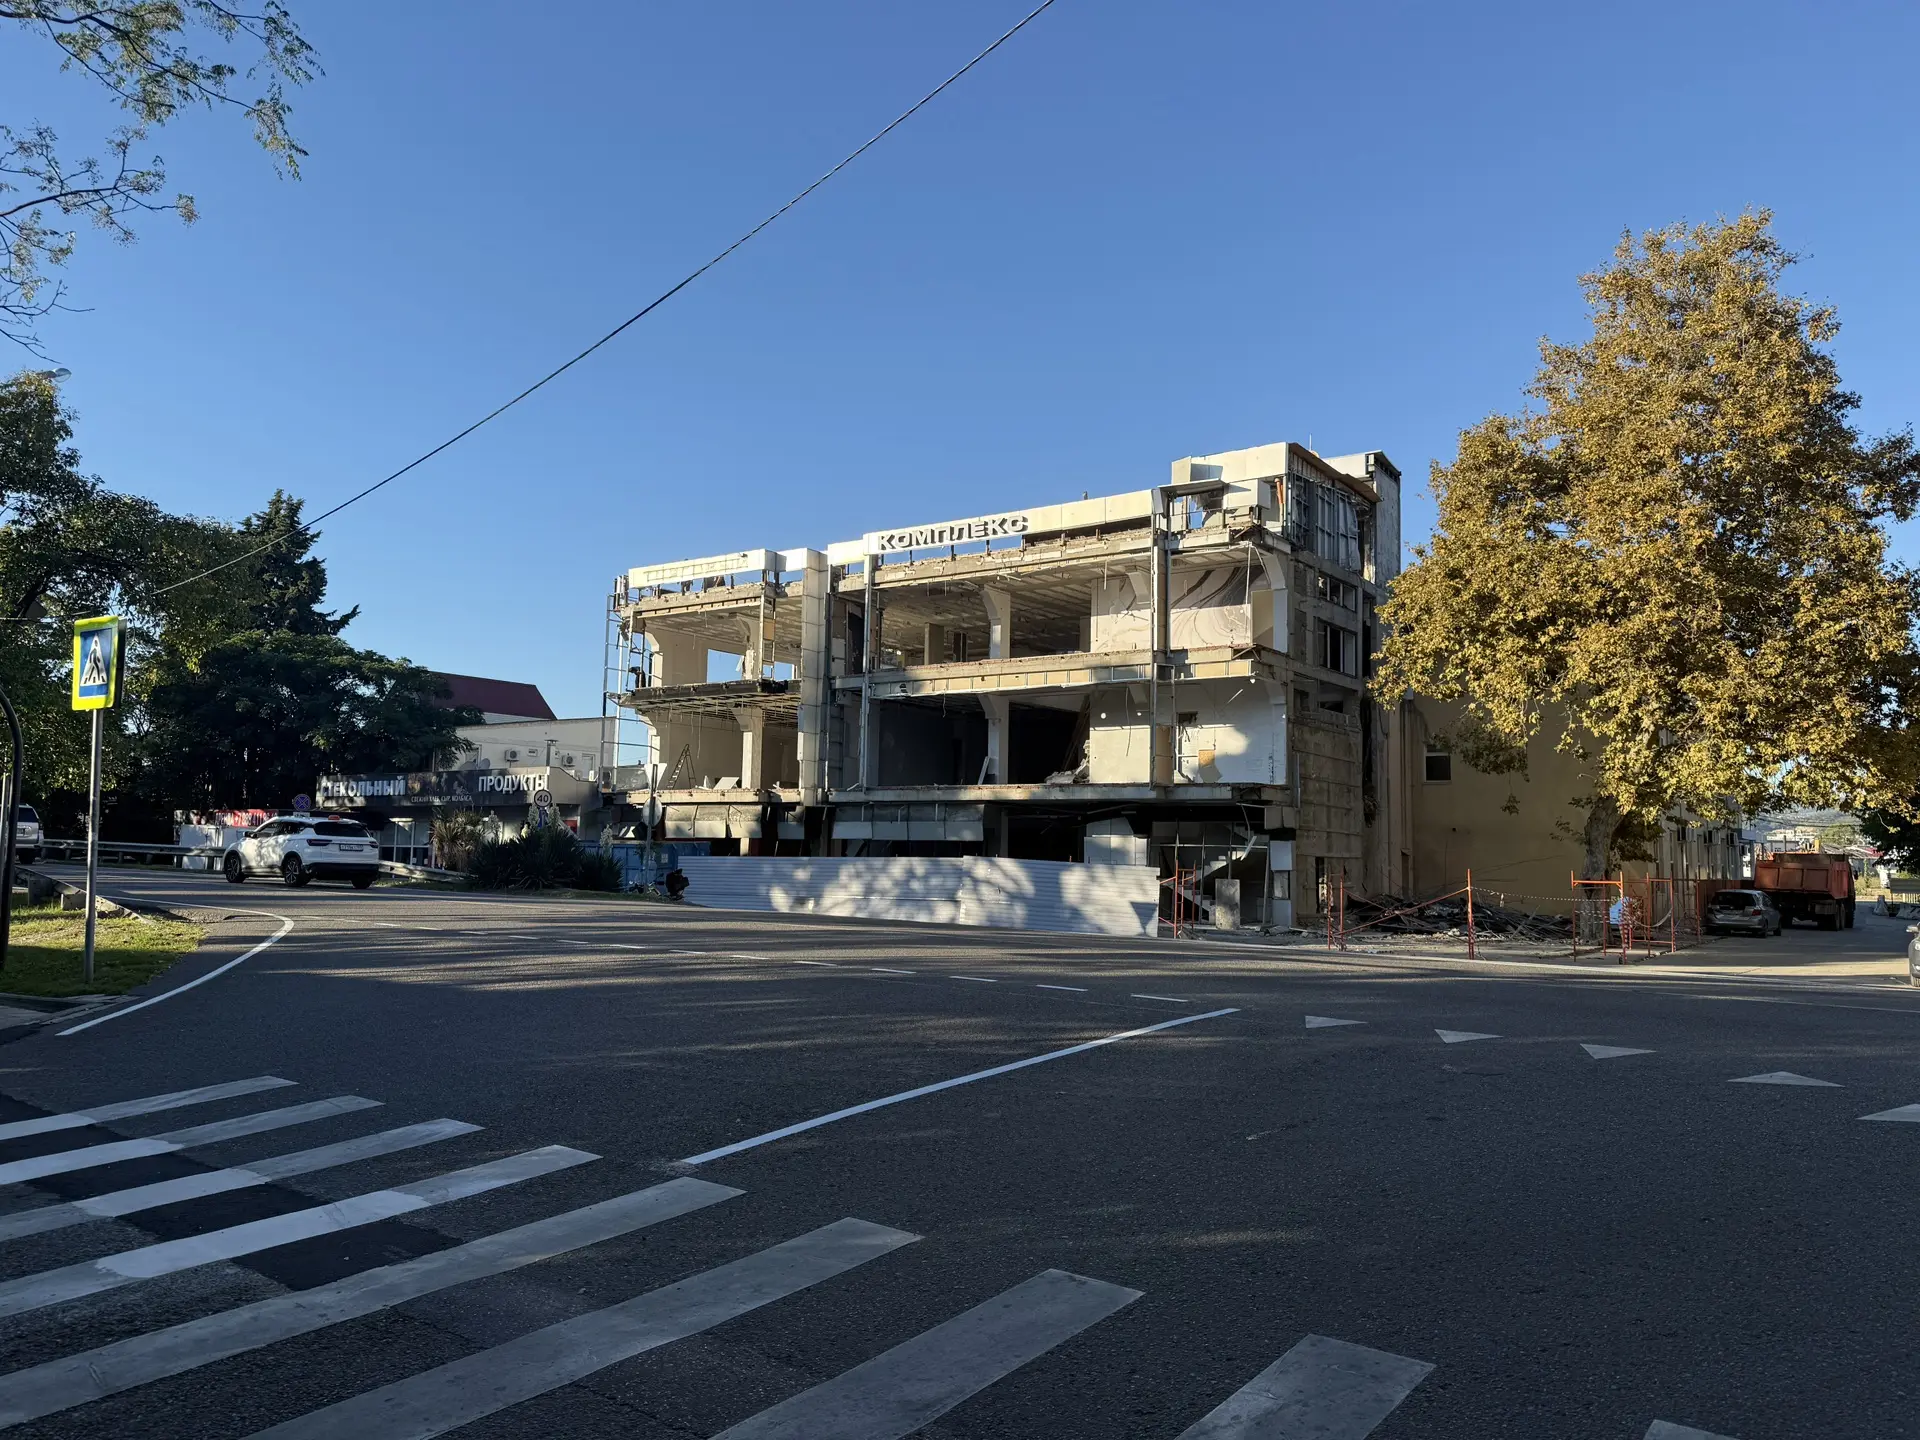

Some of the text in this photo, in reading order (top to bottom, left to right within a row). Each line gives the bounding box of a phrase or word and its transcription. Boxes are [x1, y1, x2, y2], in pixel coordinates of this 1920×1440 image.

[877, 515, 1029, 551] КОМПЛЕКС
[320, 775, 406, 797] СТЕКОЛЬНЫЙ
[478, 773, 548, 794] ПРОДУКТЫ
[537, 794, 549, 803] 40
